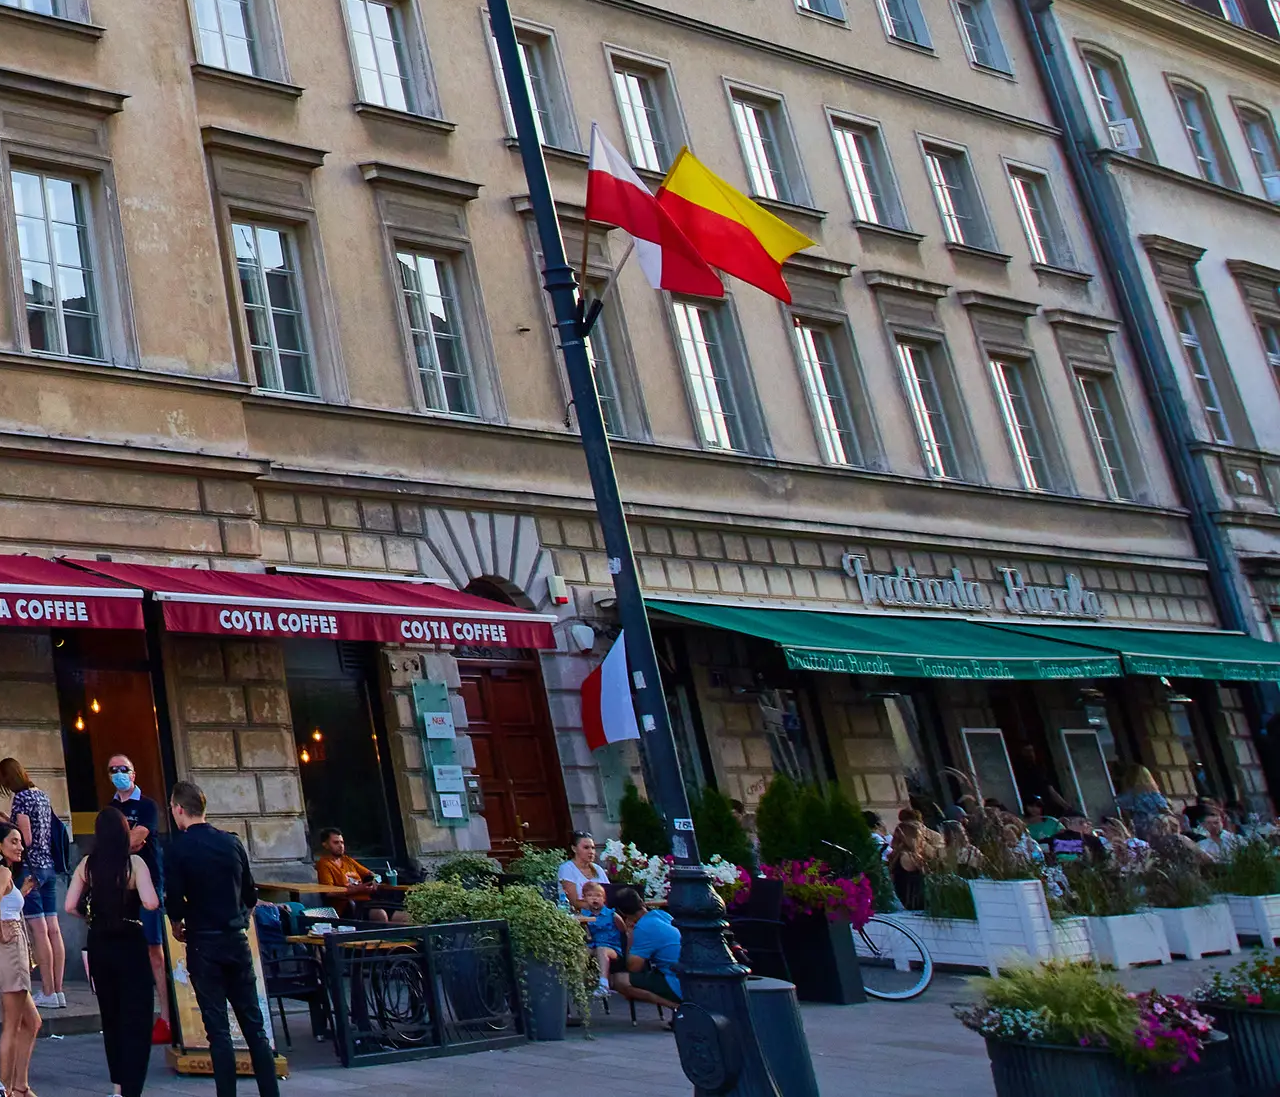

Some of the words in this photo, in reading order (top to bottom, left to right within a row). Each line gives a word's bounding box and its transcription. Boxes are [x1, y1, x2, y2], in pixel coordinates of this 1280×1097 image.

[15, 599, 89, 621] COFFEE
[219, 610, 274, 632] COSTA
[278, 612, 338, 634] COFFEE
[400, 620, 450, 641] COSTA
[452, 622, 507, 642] COFFEE
[787, 648, 847, 671] Trattoria
[846, 653, 894, 675] Rucola
[916, 658, 972, 678] Trattoria
[971, 660, 1015, 679] Rucola
